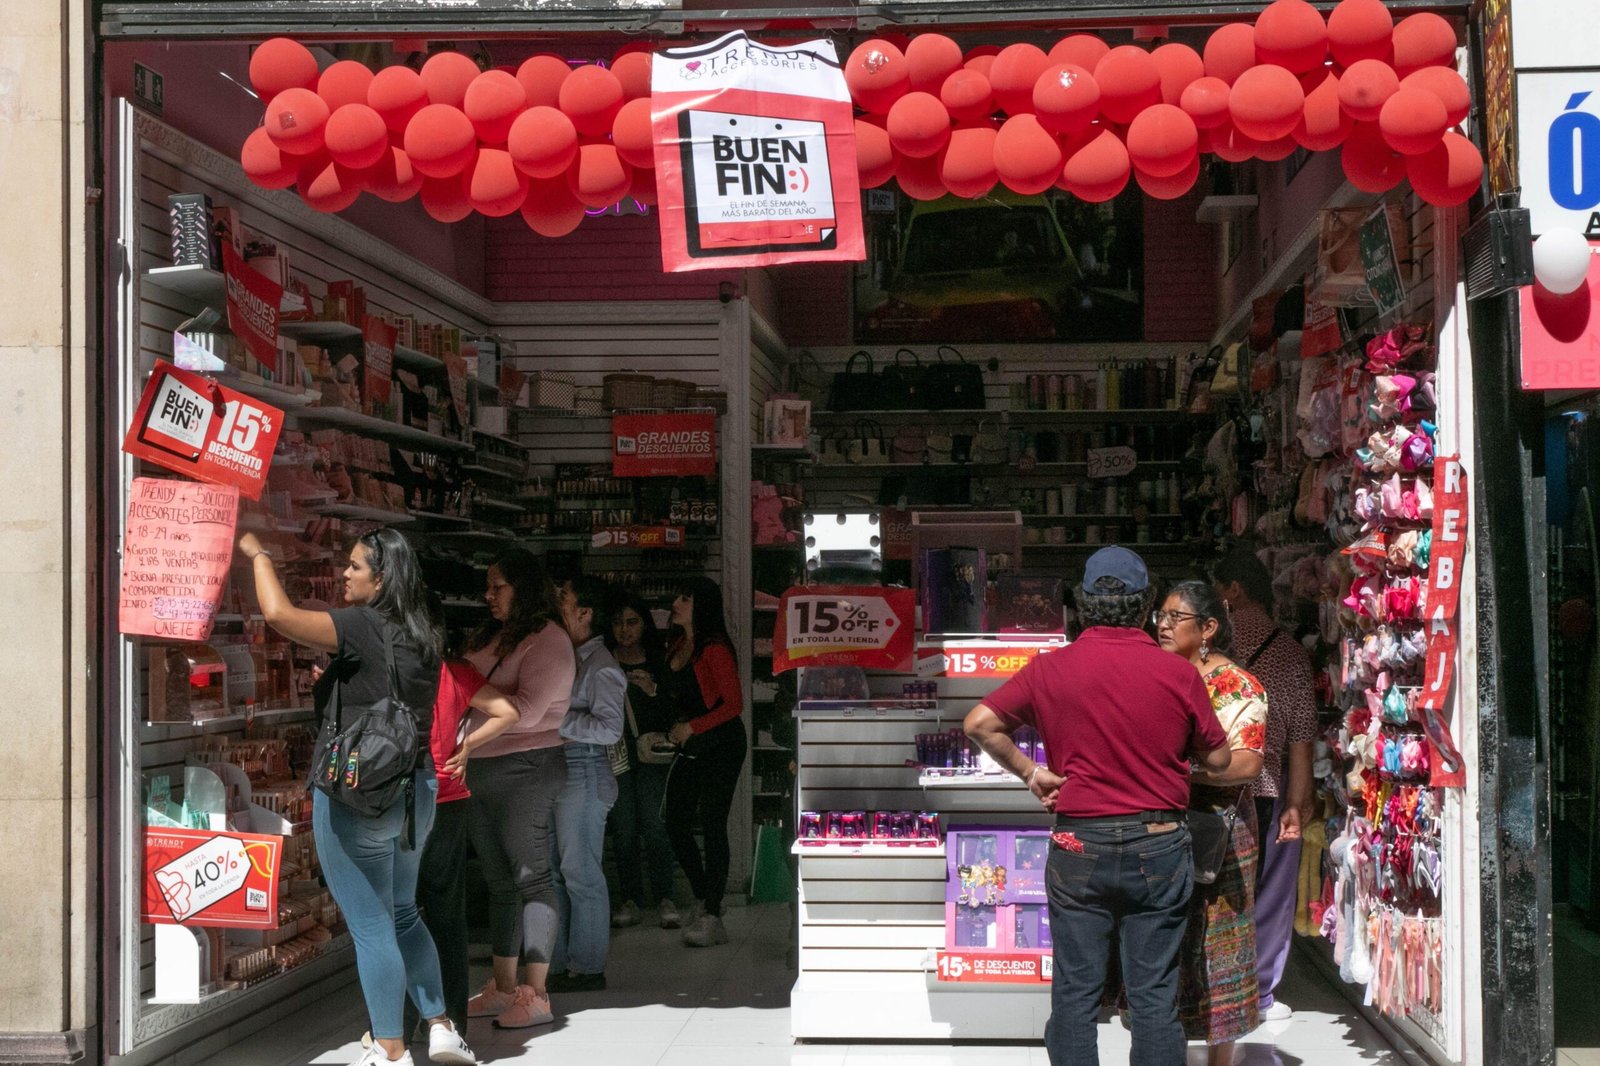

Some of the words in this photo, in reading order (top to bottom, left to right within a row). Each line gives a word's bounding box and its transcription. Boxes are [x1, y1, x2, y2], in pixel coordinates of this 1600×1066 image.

[712, 134, 808, 164] BUEN
[730, 201, 740, 209] EL
[741, 200, 755, 208] FIN
[757, 200, 768, 208] DE
[770, 200, 807, 208] SEMANA
[743, 208, 776, 217] BARATO
[778, 208, 793, 216] DEL
[166, 388, 204, 420] BUEN
[637, 431, 710, 444] GRANDES
[208, 440, 263, 471] DESCUENTO
[637, 443, 711, 454] DESCUENTOS
[204, 452, 214, 461] EN
[214, 455, 230, 469] TODA
[230, 462, 239, 472] LA
[239, 465, 261, 480] TIENDA
[1103, 455, 1131, 468] 50%
[134, 481, 176, 504] TRENDY
[193, 486, 235, 508] SOLICITA
[128, 501, 190, 525] ACCESORIES
[191, 505, 234, 522] PERSONAL
[132, 544, 158, 556] GUSTO
[162, 549, 177, 557] POR
[179, 550, 188, 558] EL
[165, 558, 198, 569] VENTAS
[130, 571, 157, 582] BUENA
[841, 619, 879, 633] OFF
[807, 636, 830, 644] TODA
[848, 636, 880, 644] TIENDA
[154, 838, 185, 846] TRENDY
[194, 850, 238, 889] 40%
[974, 960, 985, 969] DE
[987, 960, 1036, 970] DESCUENTO
